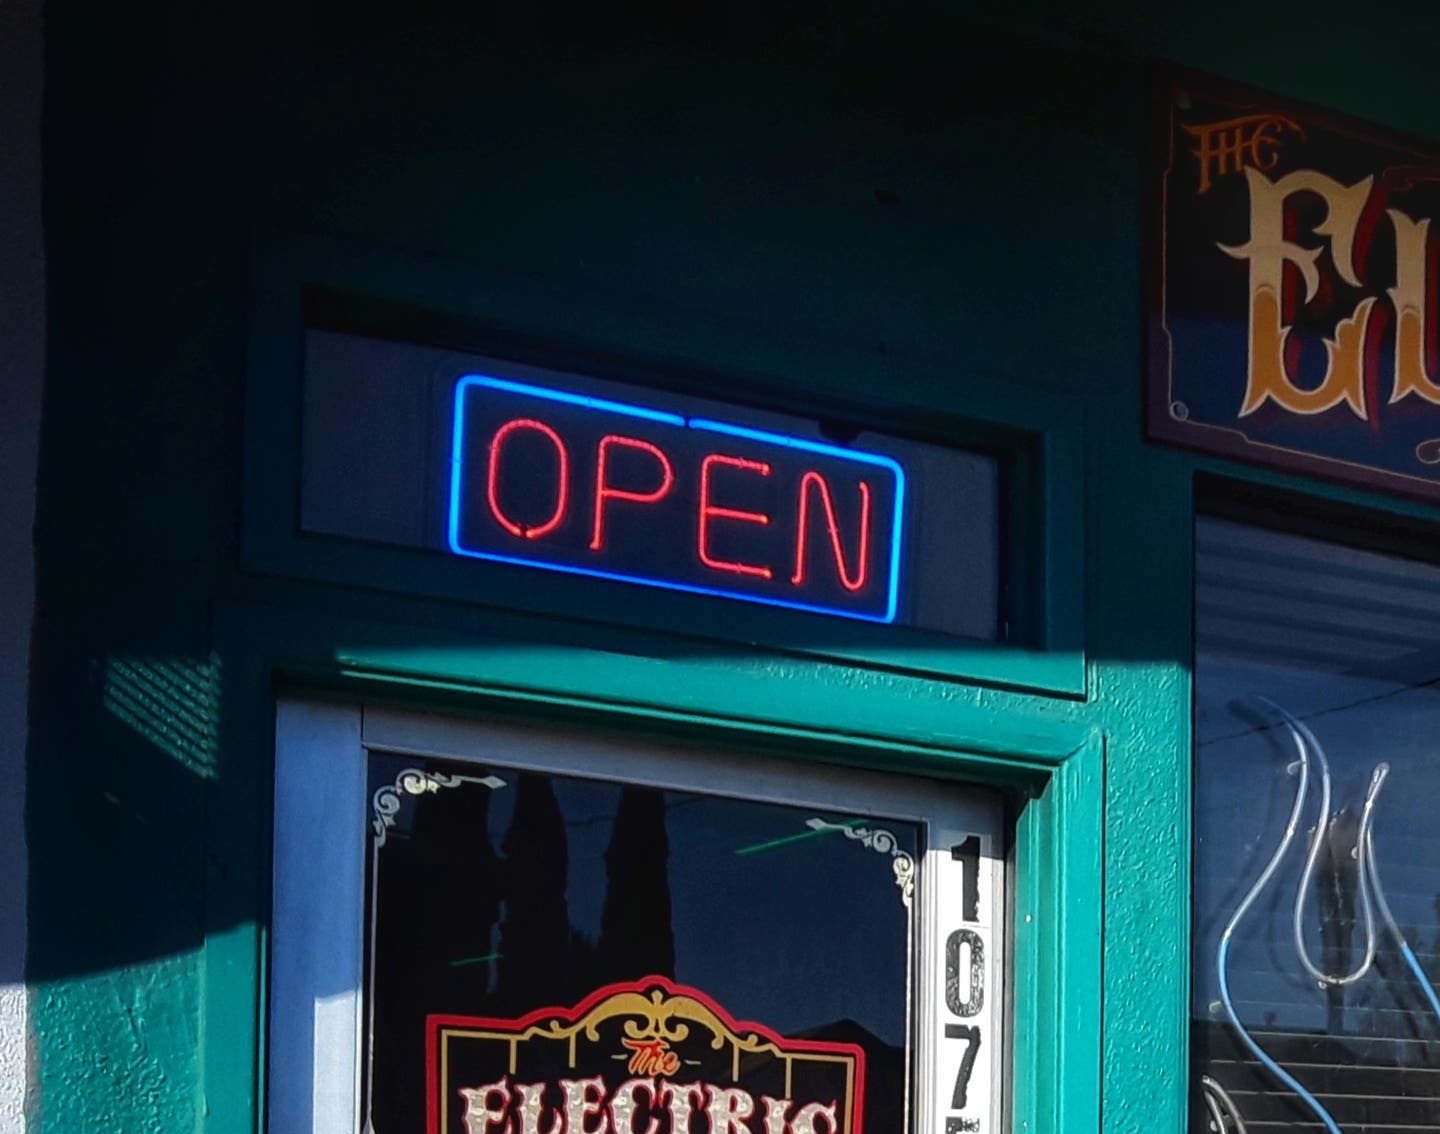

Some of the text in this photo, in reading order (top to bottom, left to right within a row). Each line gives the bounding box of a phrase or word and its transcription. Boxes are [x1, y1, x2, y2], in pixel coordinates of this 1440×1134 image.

[1182, 112, 1307, 195] THE
[486, 417, 873, 591] OPEN
[620, 1037, 681, 1075] The
